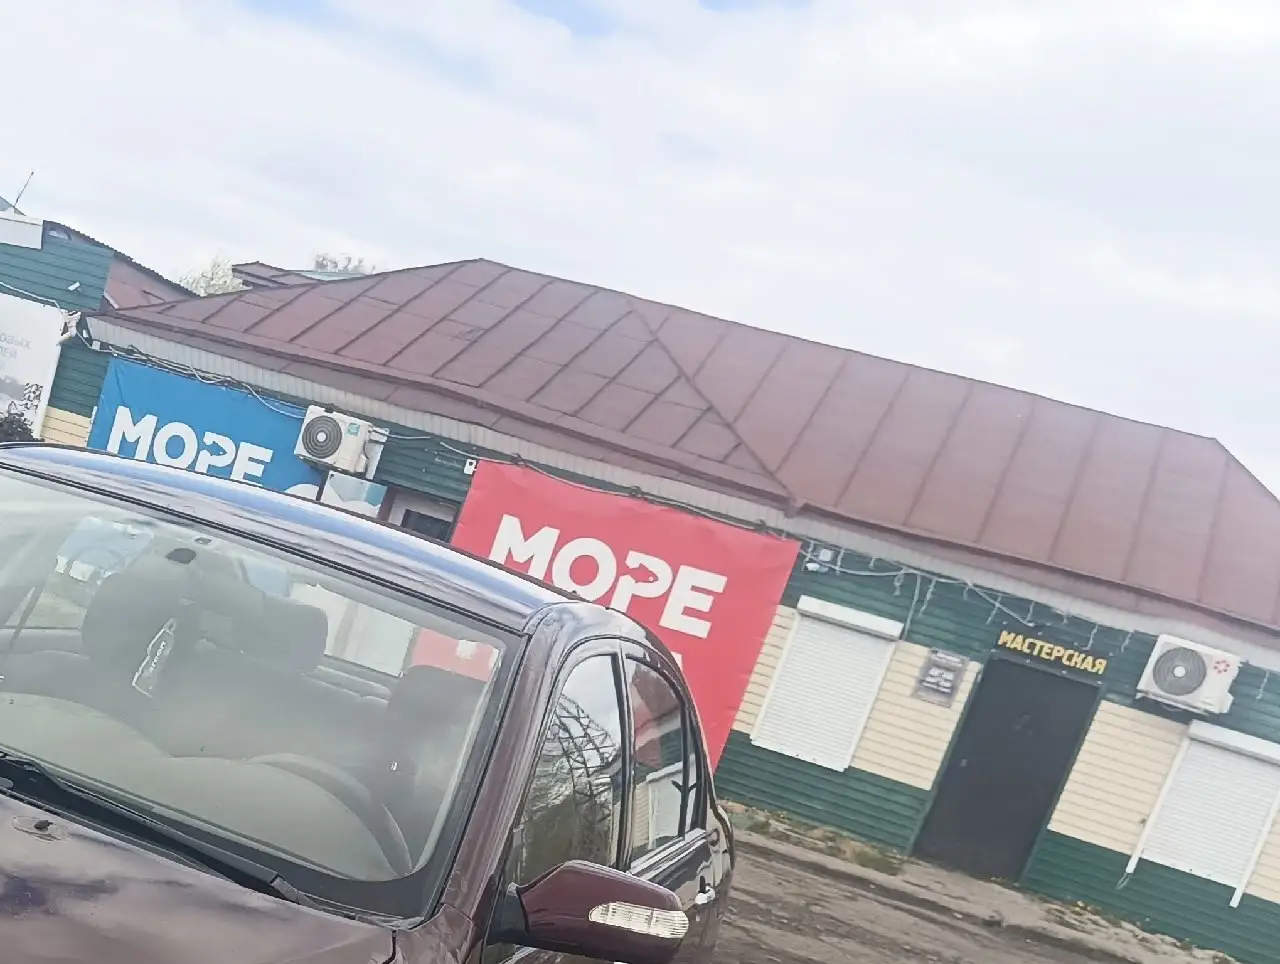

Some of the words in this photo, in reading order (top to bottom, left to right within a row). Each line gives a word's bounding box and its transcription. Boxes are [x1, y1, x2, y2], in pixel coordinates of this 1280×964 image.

[106, 405, 274, 487] МОРЕ
[488, 513, 728, 639] МОРЕ
[998, 630, 1107, 675] МАСТЕРСКАЯ
